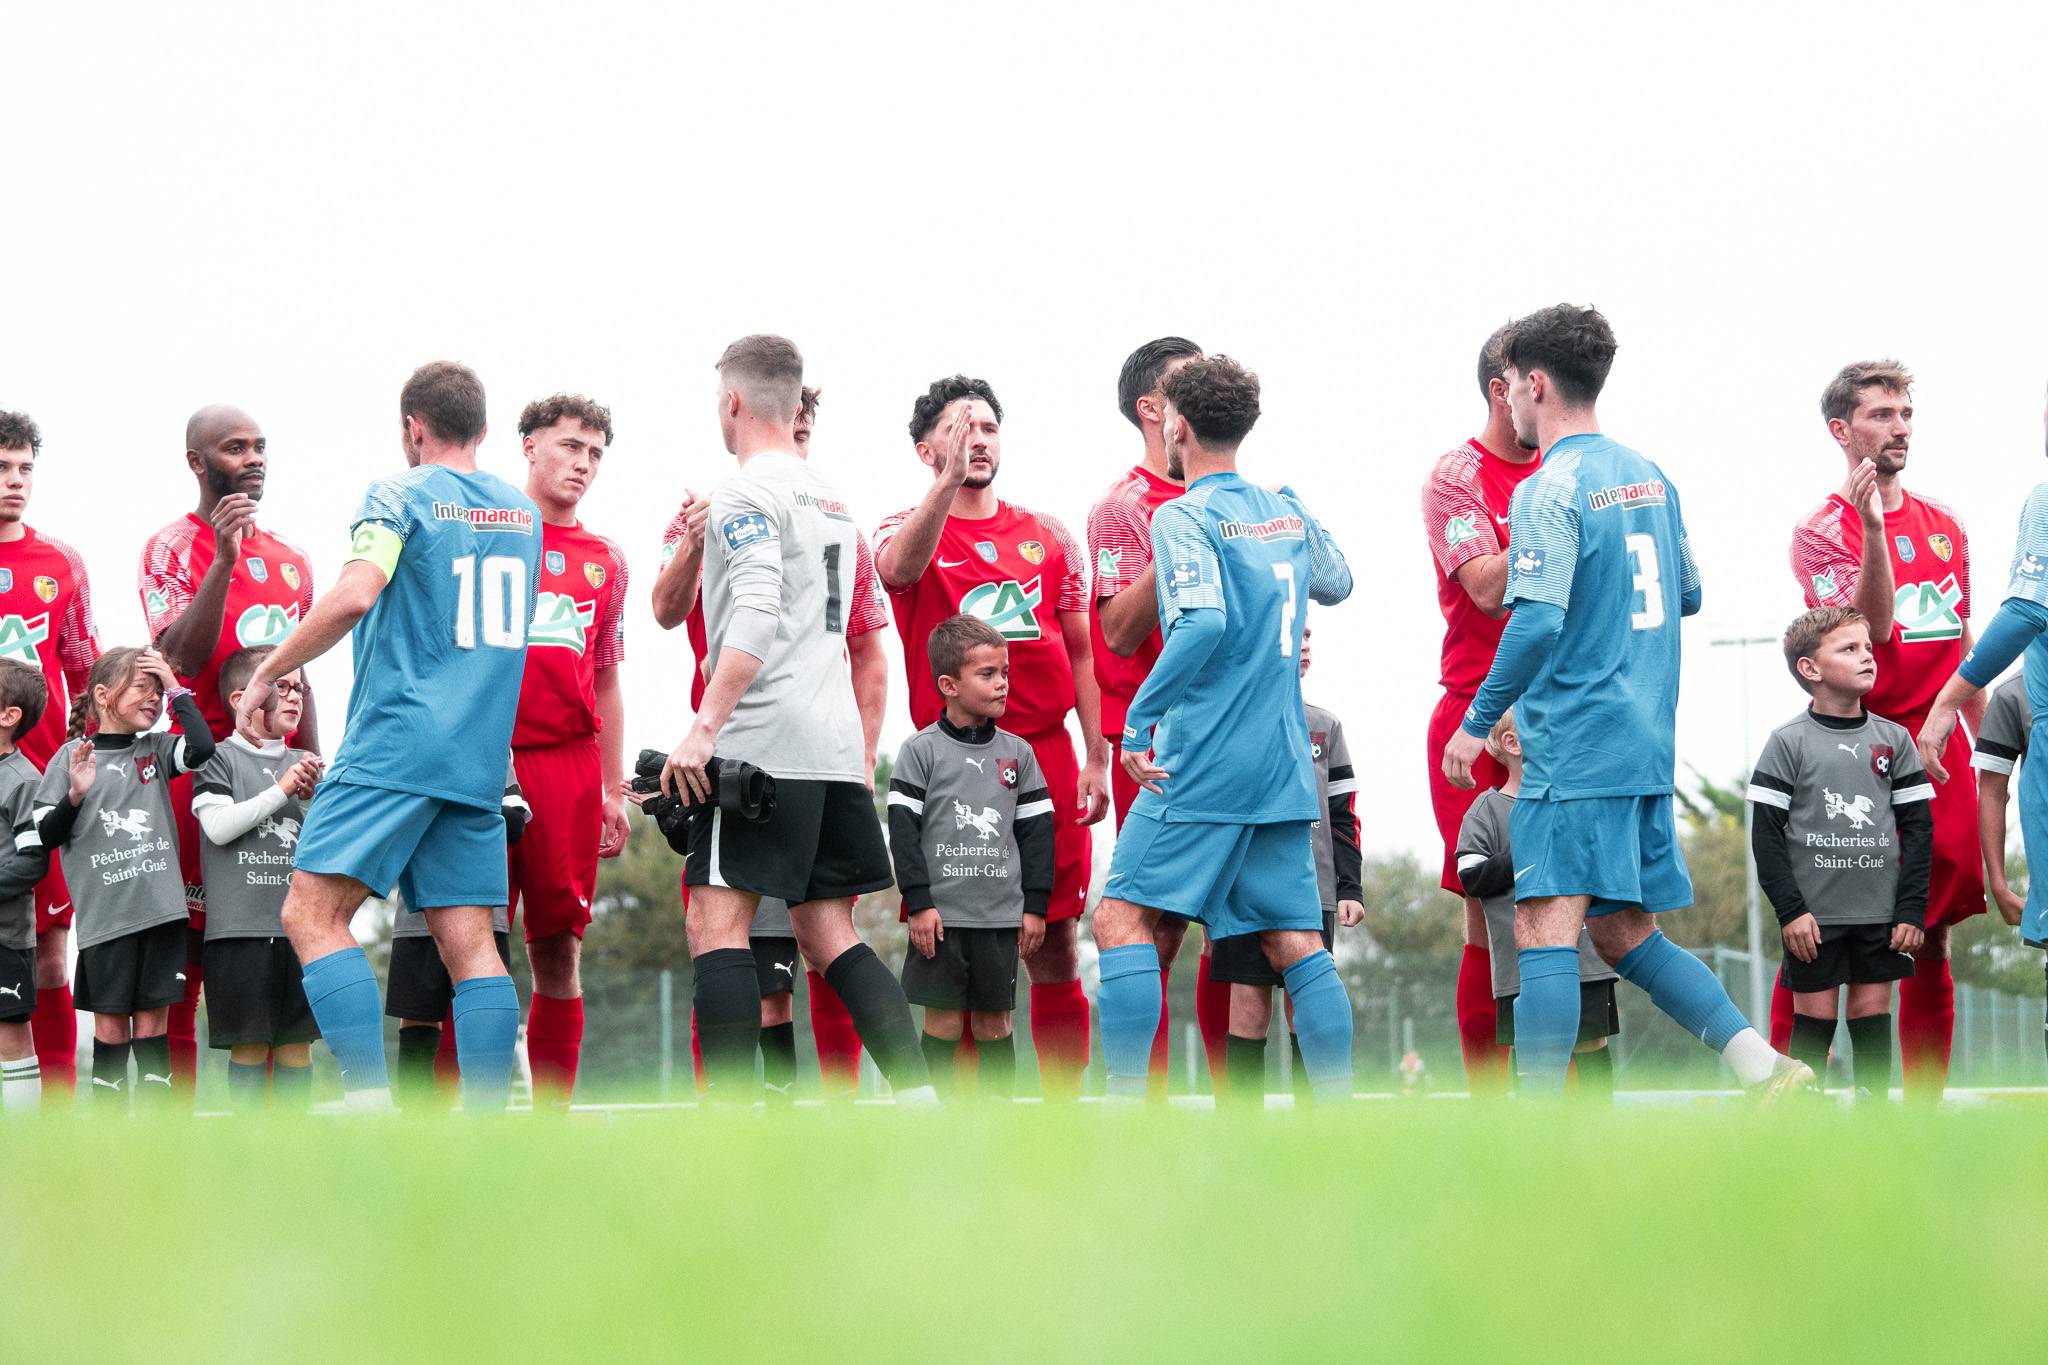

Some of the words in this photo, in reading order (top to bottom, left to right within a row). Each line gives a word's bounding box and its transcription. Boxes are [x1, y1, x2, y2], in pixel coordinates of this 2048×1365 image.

[352, 530, 374, 553] C
[823, 544, 841, 633] 1
[1624, 533, 1665, 631] 3
[452, 553, 527, 650] 10
[1271, 562, 1297, 657] 7
[90, 843, 154, 868] Pêcheries
[156, 837, 170, 850] de
[936, 842, 1000, 857] Pêcheries
[1806, 833, 1875, 847] Pêcheries
[1878, 833, 1890, 847] de
[237, 850, 296, 865] Pêcherie
[1814, 854, 1885, 869] Saint-Gué
[102, 858, 168, 886] Saint-Gué
[942, 863, 1008, 878] Saint-Gué
